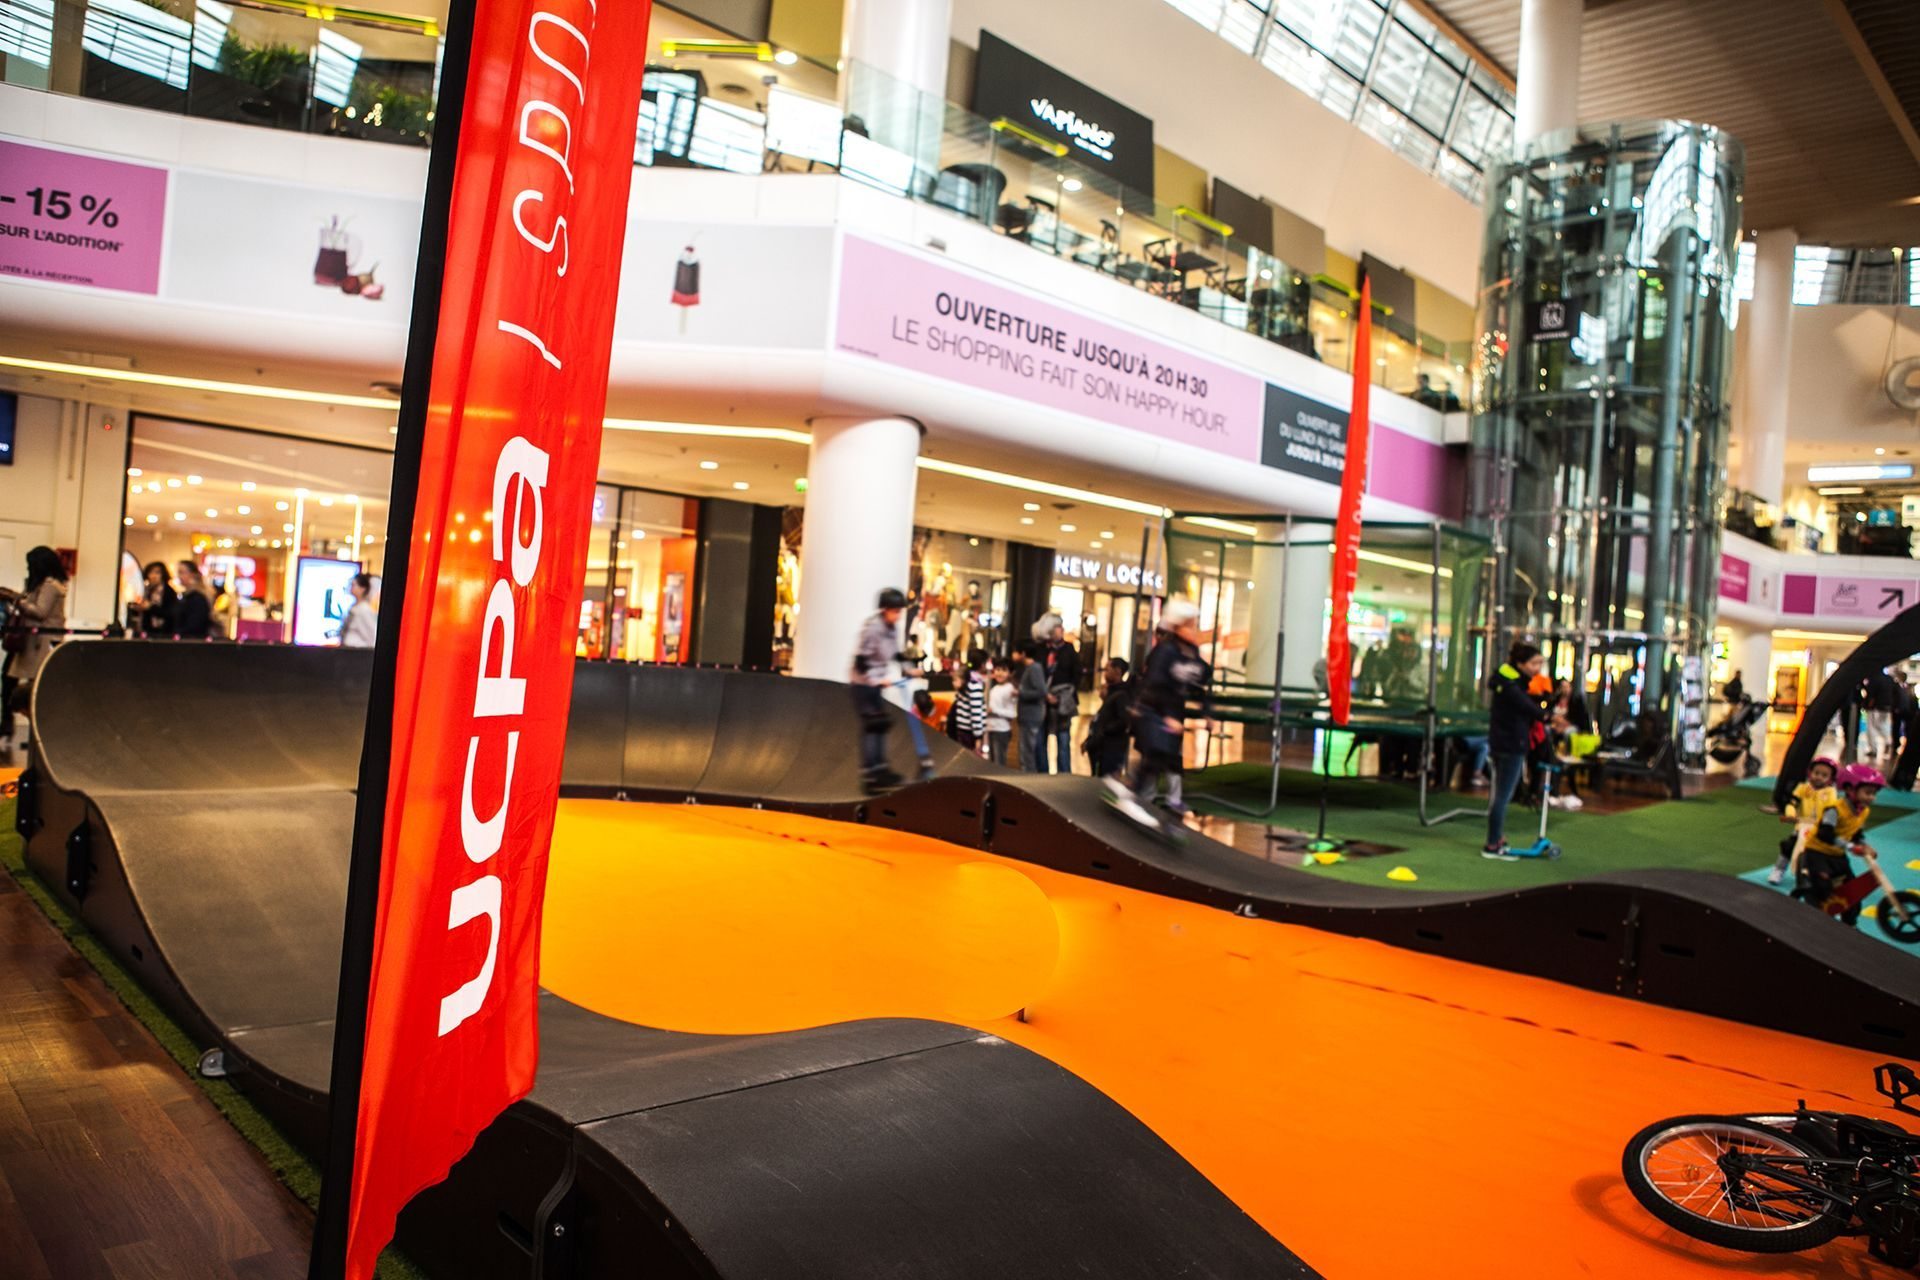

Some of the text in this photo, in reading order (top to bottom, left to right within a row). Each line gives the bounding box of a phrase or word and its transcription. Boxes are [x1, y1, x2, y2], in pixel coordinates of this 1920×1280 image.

[0, 223, 30, 239] SUR
[892, 315, 920, 346] LE
[926, 325, 1035, 378] SHOPPING
[1040, 360, 1078, 391] FAIT
[1083, 372, 1121, 403] SON
[1125, 386, 1179, 420] HAPPY
[935, 291, 1068, 353] OUVERTURE
[1072, 337, 1150, 381] JUSQU'À
[1055, 554, 1101, 579] NEW
[438, 435, 550, 1038] ucpa
